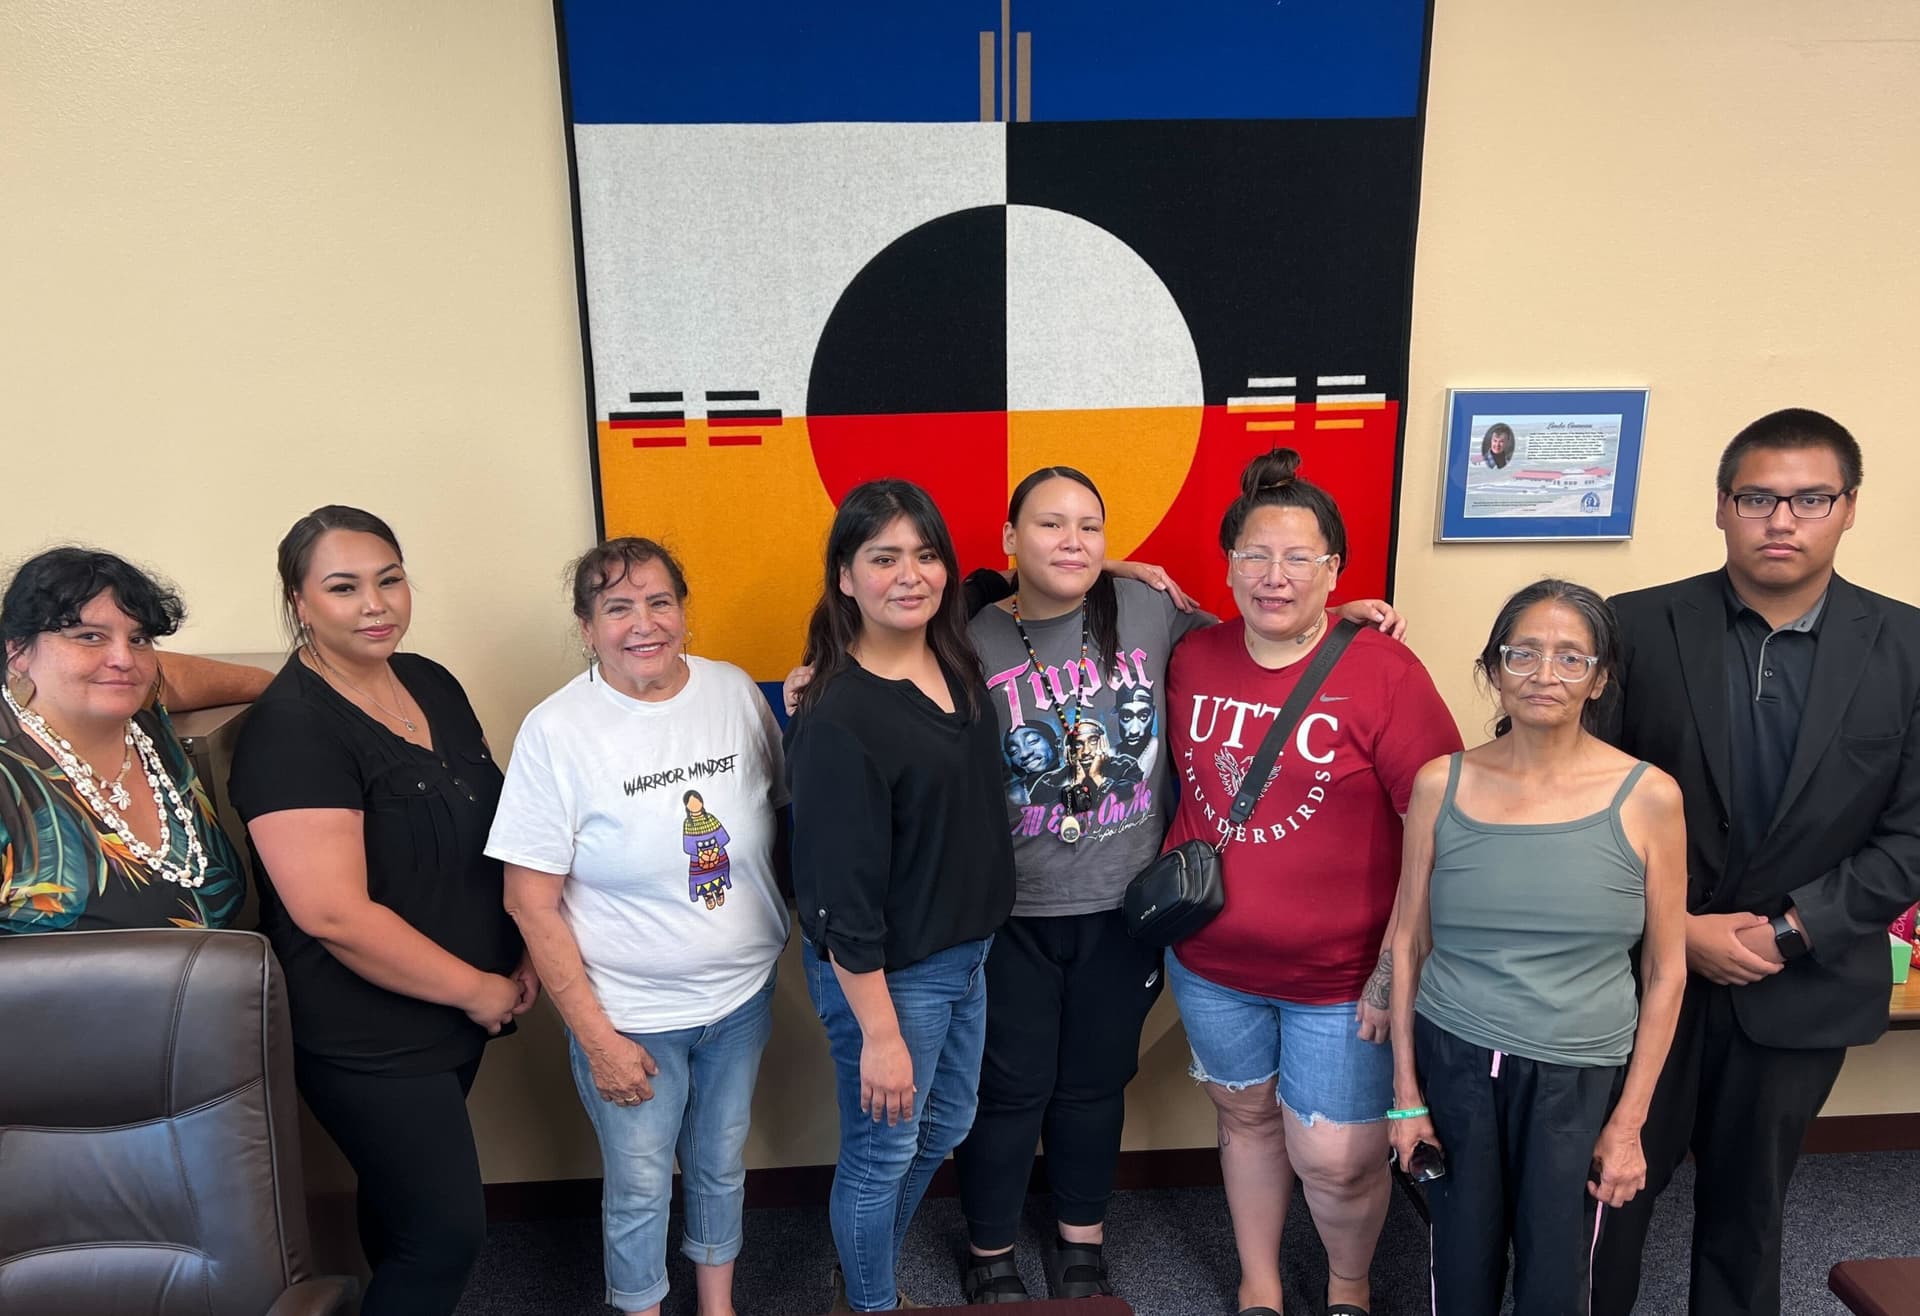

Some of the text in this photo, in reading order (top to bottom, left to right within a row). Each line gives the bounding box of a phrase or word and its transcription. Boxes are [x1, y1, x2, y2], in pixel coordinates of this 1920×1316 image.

[623, 753, 739, 797] WARRIOR MINDSET
[1184, 747, 1331, 844] THUNDERBIRDS
[1098, 792, 1125, 826] On
